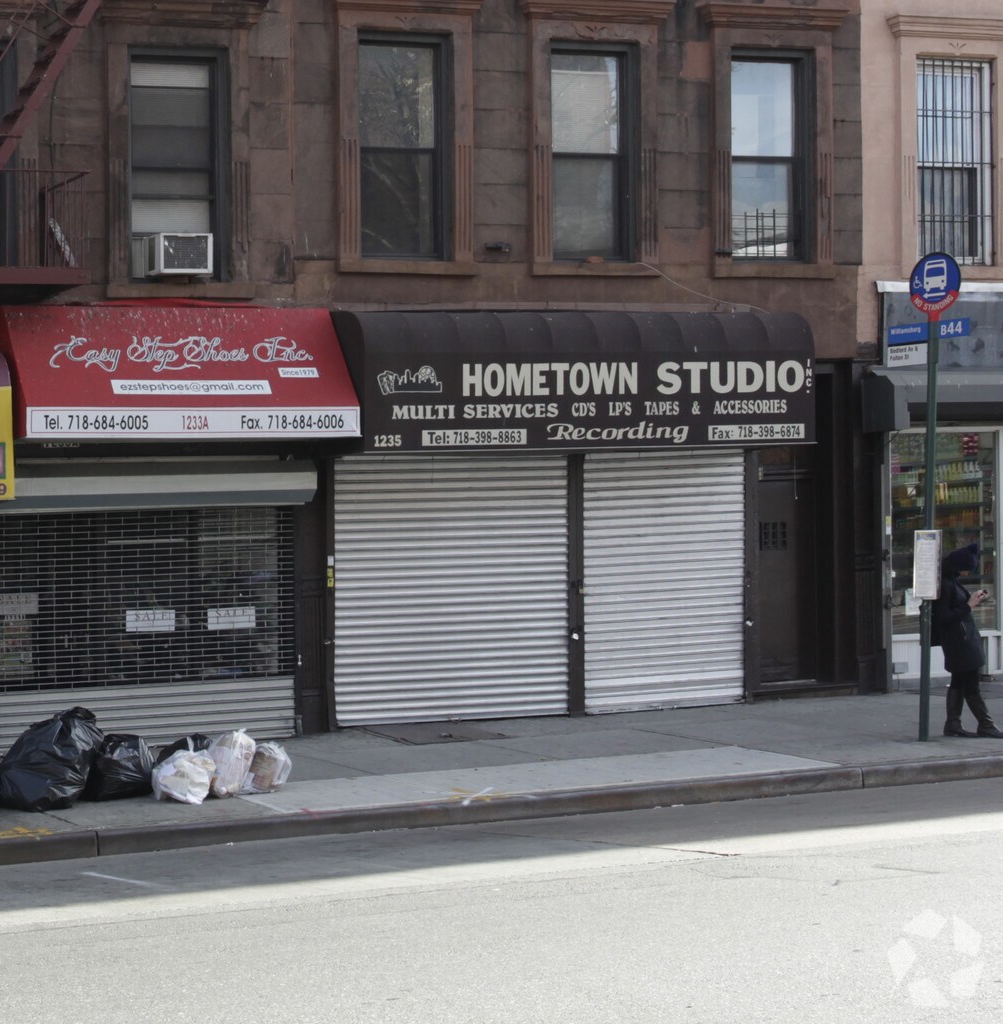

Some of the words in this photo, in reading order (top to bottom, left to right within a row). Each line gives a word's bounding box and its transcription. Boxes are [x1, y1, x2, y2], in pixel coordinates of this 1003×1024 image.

[913, 297, 923, 307] NO
[923, 294, 954, 311] STANDING
[940, 321, 963, 336] B44
[49, 335, 121, 372] Easy
[127, 336, 183, 372] Step
[183, 336, 249, 363] Shoes
[252, 336, 314, 363] Inc.
[462, 362, 638, 397] HOMETOWN
[656, 360, 805, 395] STUDIO
[120, 381, 264, 393] ezstepshoes@gmail.com
[392, 405, 456, 420] MULTI
[463, 403, 559, 419] SERVICES
[572, 402, 596, 417] CD'S
[609, 401, 632, 416] LP'S
[644, 401, 680, 416] TAPES
[692, 401, 701, 415] &
[713, 399, 788, 415] ACCESSORIES
[44, 415, 63, 430] Tel.
[67, 414, 149, 430] 718-684-6005
[181, 415, 209, 430] 1233A
[241, 415, 263, 430] Fax.
[267, 413, 344, 430] 718-684-6006
[428, 431, 450, 444] Tel:
[453, 430, 522, 444] 718-398-8863
[547, 421, 689, 443] Recording
[711, 427, 734, 440] Fax:
[738, 425, 801, 439] 718-398-6874
[374, 434, 402, 448] 1235
